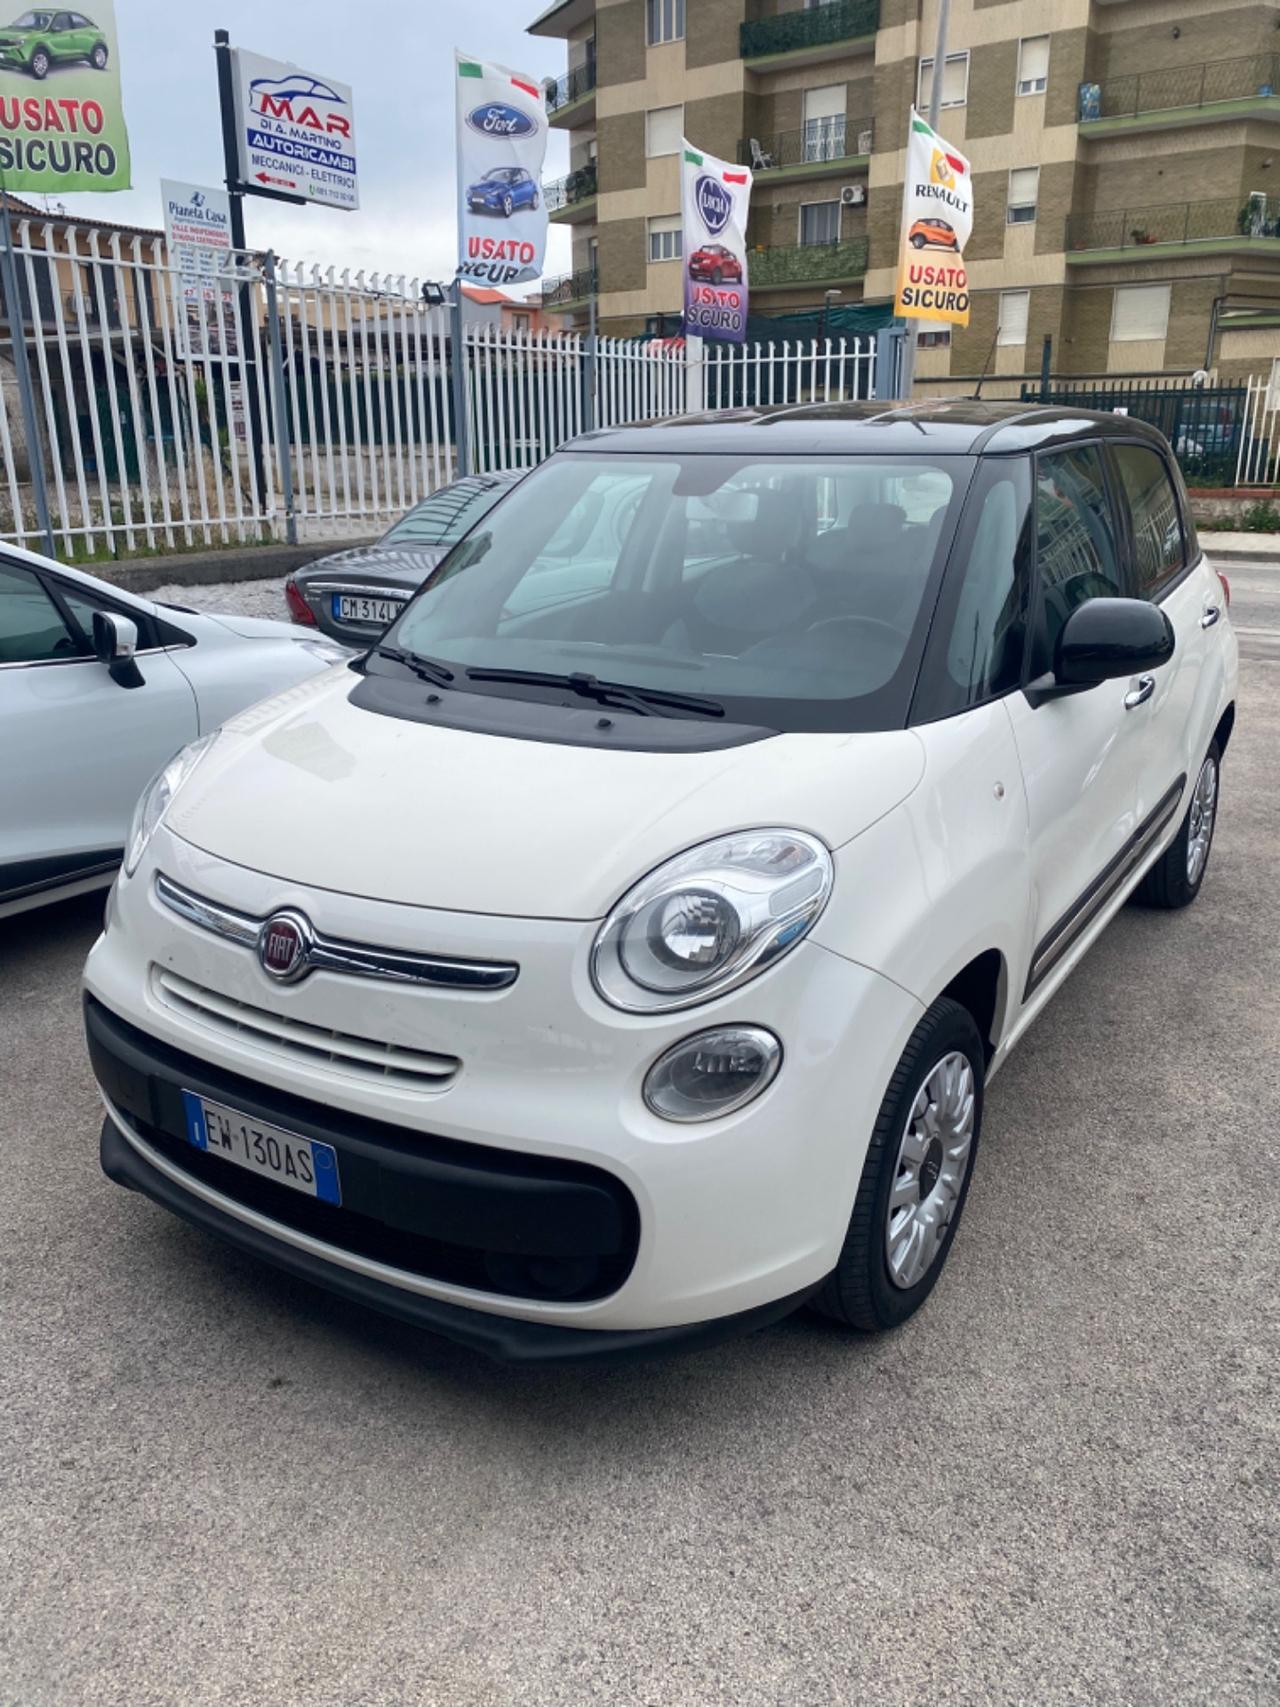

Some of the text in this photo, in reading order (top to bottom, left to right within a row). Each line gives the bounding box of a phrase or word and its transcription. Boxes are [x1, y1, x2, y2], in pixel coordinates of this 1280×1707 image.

[0, 96, 104, 135] USATO
[260, 93, 351, 139] MAR
[260, 119, 272, 131] DI
[289, 127, 342, 150] MARTINO
[0, 137, 116, 176] SICURO
[252, 133, 354, 170] AUTORICAMBI
[251, 153, 304, 176] MECCANICI
[311, 168, 355, 189] ELETTRICI
[168, 201, 204, 219] Pianeta
[206, 207, 227, 224] Casa
[915, 184, 969, 213] RENAULT
[468, 236, 535, 264] USATO
[909, 265, 967, 289] USATO
[901, 287, 969, 312] SICURO
[268, 932, 294, 962] FIAT
